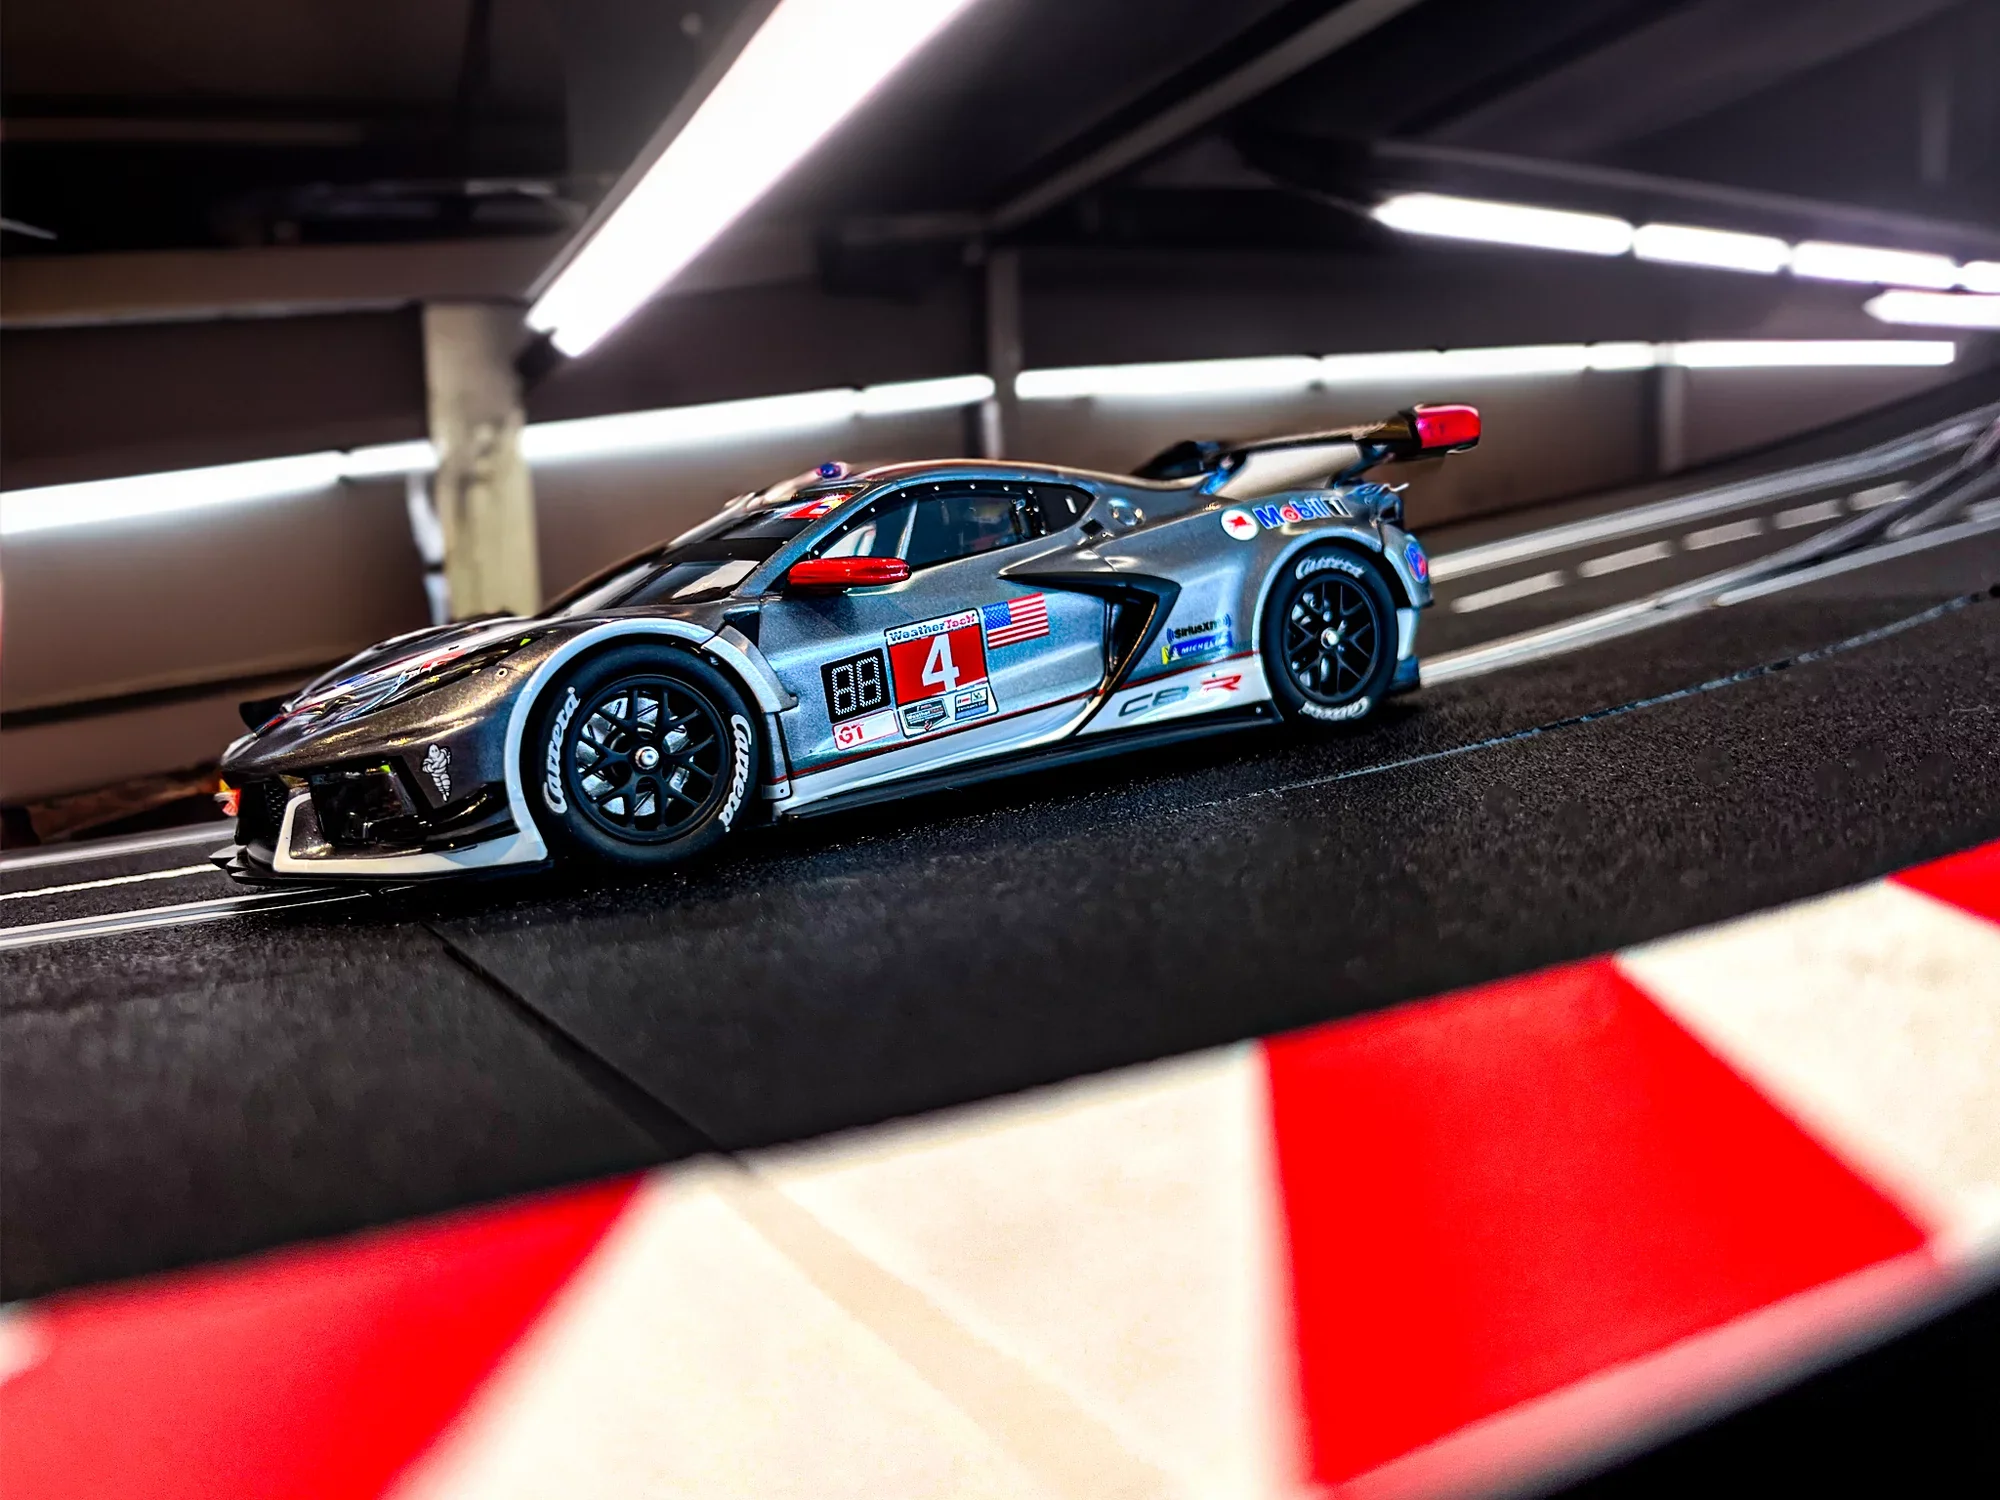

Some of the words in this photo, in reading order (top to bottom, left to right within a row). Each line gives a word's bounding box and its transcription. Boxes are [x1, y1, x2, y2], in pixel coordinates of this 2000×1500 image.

[1252, 496, 1331, 529] Mobil
[1294, 555, 1366, 581] Carrera
[889, 613, 976, 642] WeatherTech
[1181, 636, 1228, 654] MICHELI
[921, 632, 960, 693] 4
[831, 655, 882, 716] 88
[1300, 695, 1369, 722] Carrera
[838, 721, 865, 745] GT
[543, 687, 581, 815] Carrera
[717, 713, 753, 834] Carrera
